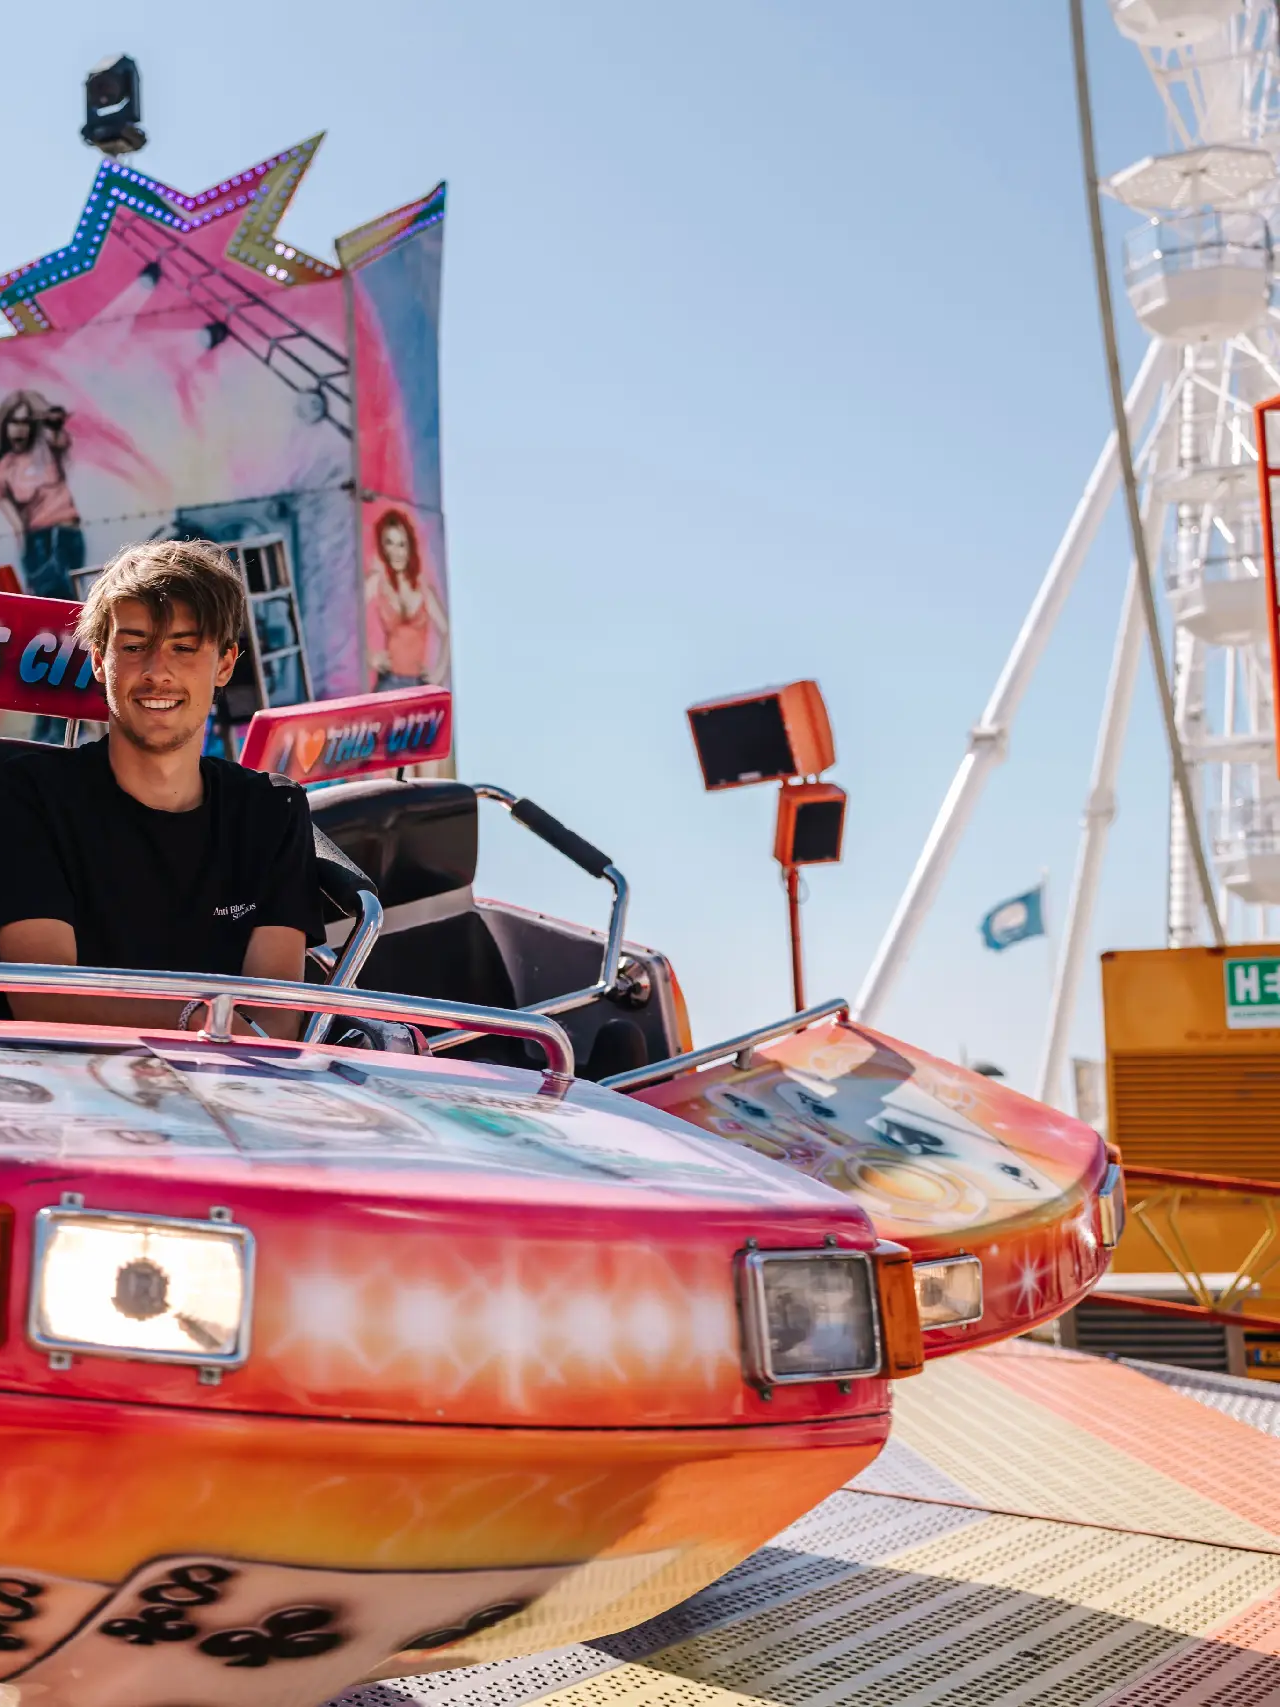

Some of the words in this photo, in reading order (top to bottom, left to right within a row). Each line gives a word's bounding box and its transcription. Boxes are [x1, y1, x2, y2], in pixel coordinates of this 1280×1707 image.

[324, 721, 382, 765] THIS
[387, 709, 445, 752] CITY
[213, 906, 229, 916] Anti
[230, 903, 246, 914] Blue
